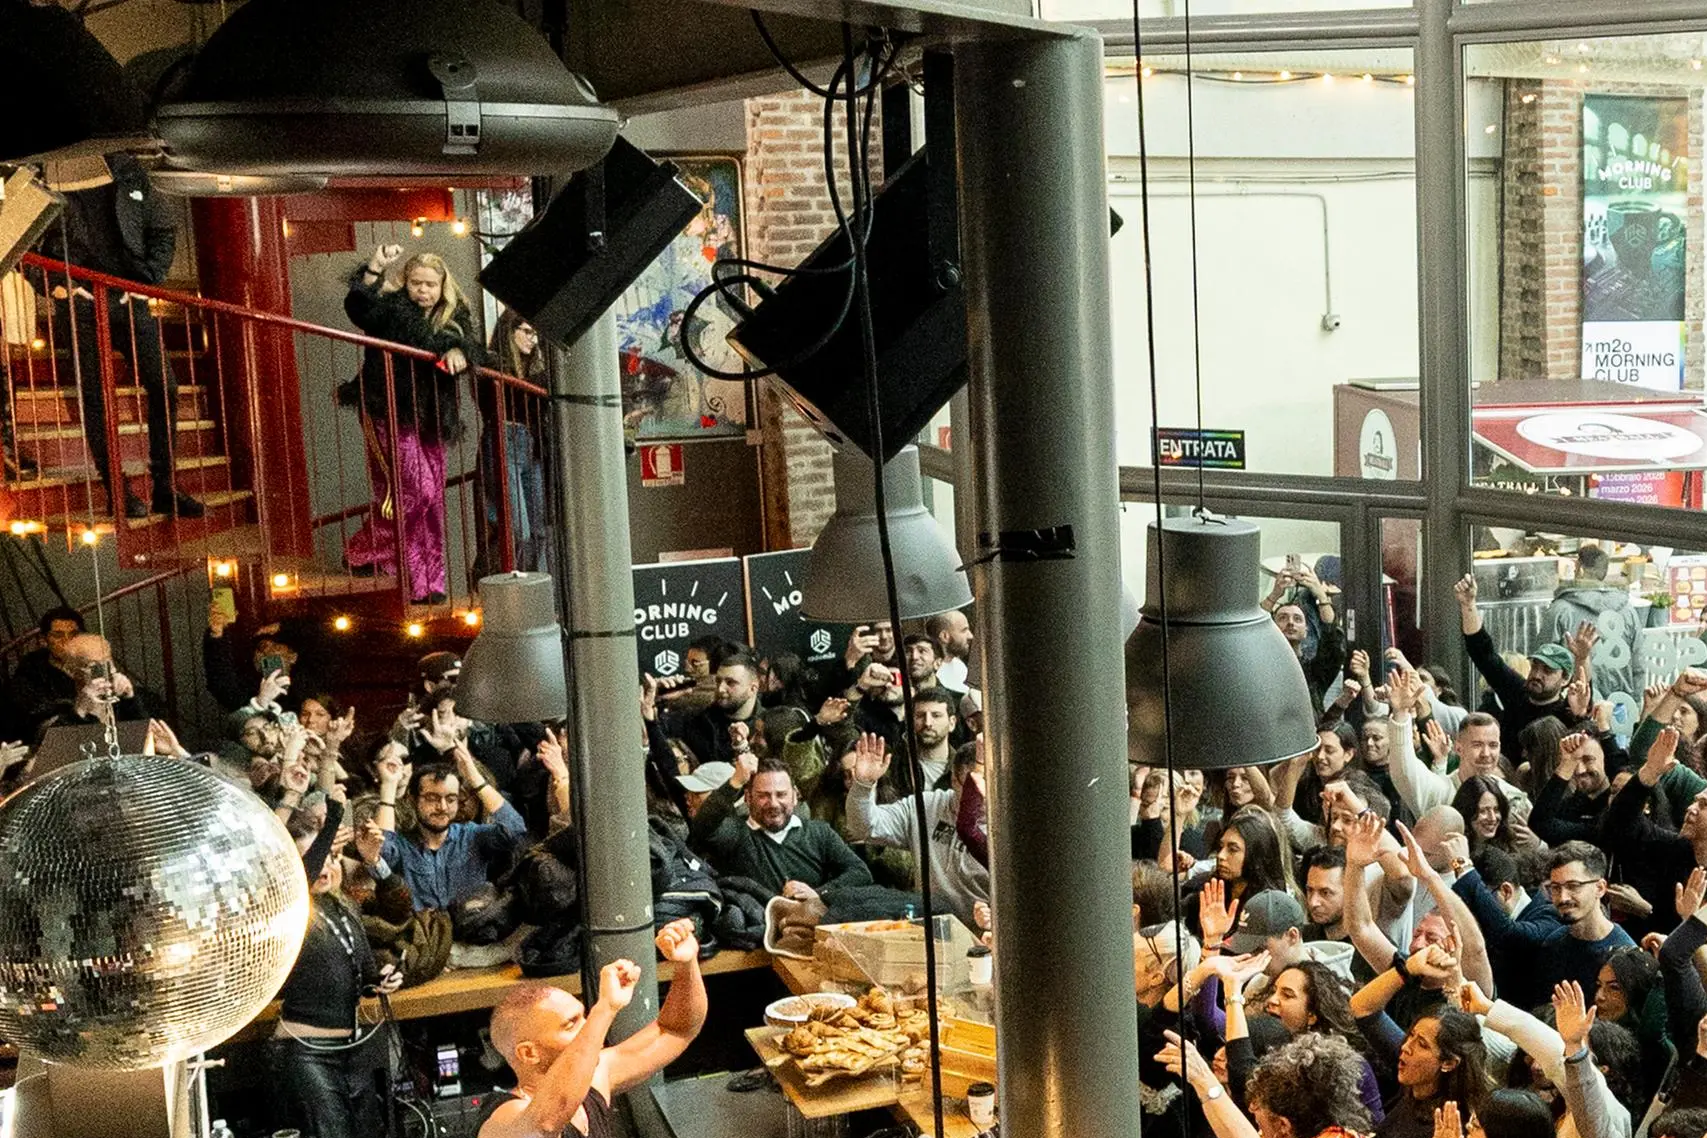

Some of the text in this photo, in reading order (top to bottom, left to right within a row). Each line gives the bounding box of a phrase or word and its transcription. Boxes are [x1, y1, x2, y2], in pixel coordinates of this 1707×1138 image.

[1598, 159, 1672, 181] MORNING
[1619, 177, 1652, 190] CLUB
[1595, 338, 1632, 353] m2o
[1595, 353, 1675, 368] MORNING
[1595, 368, 1640, 382] CLUB
[1159, 438, 1237, 459] ENTRATA
[1601, 485, 1630, 493] marzo
[633, 602, 717, 624] ORNING
[641, 623, 690, 641] CLUB
